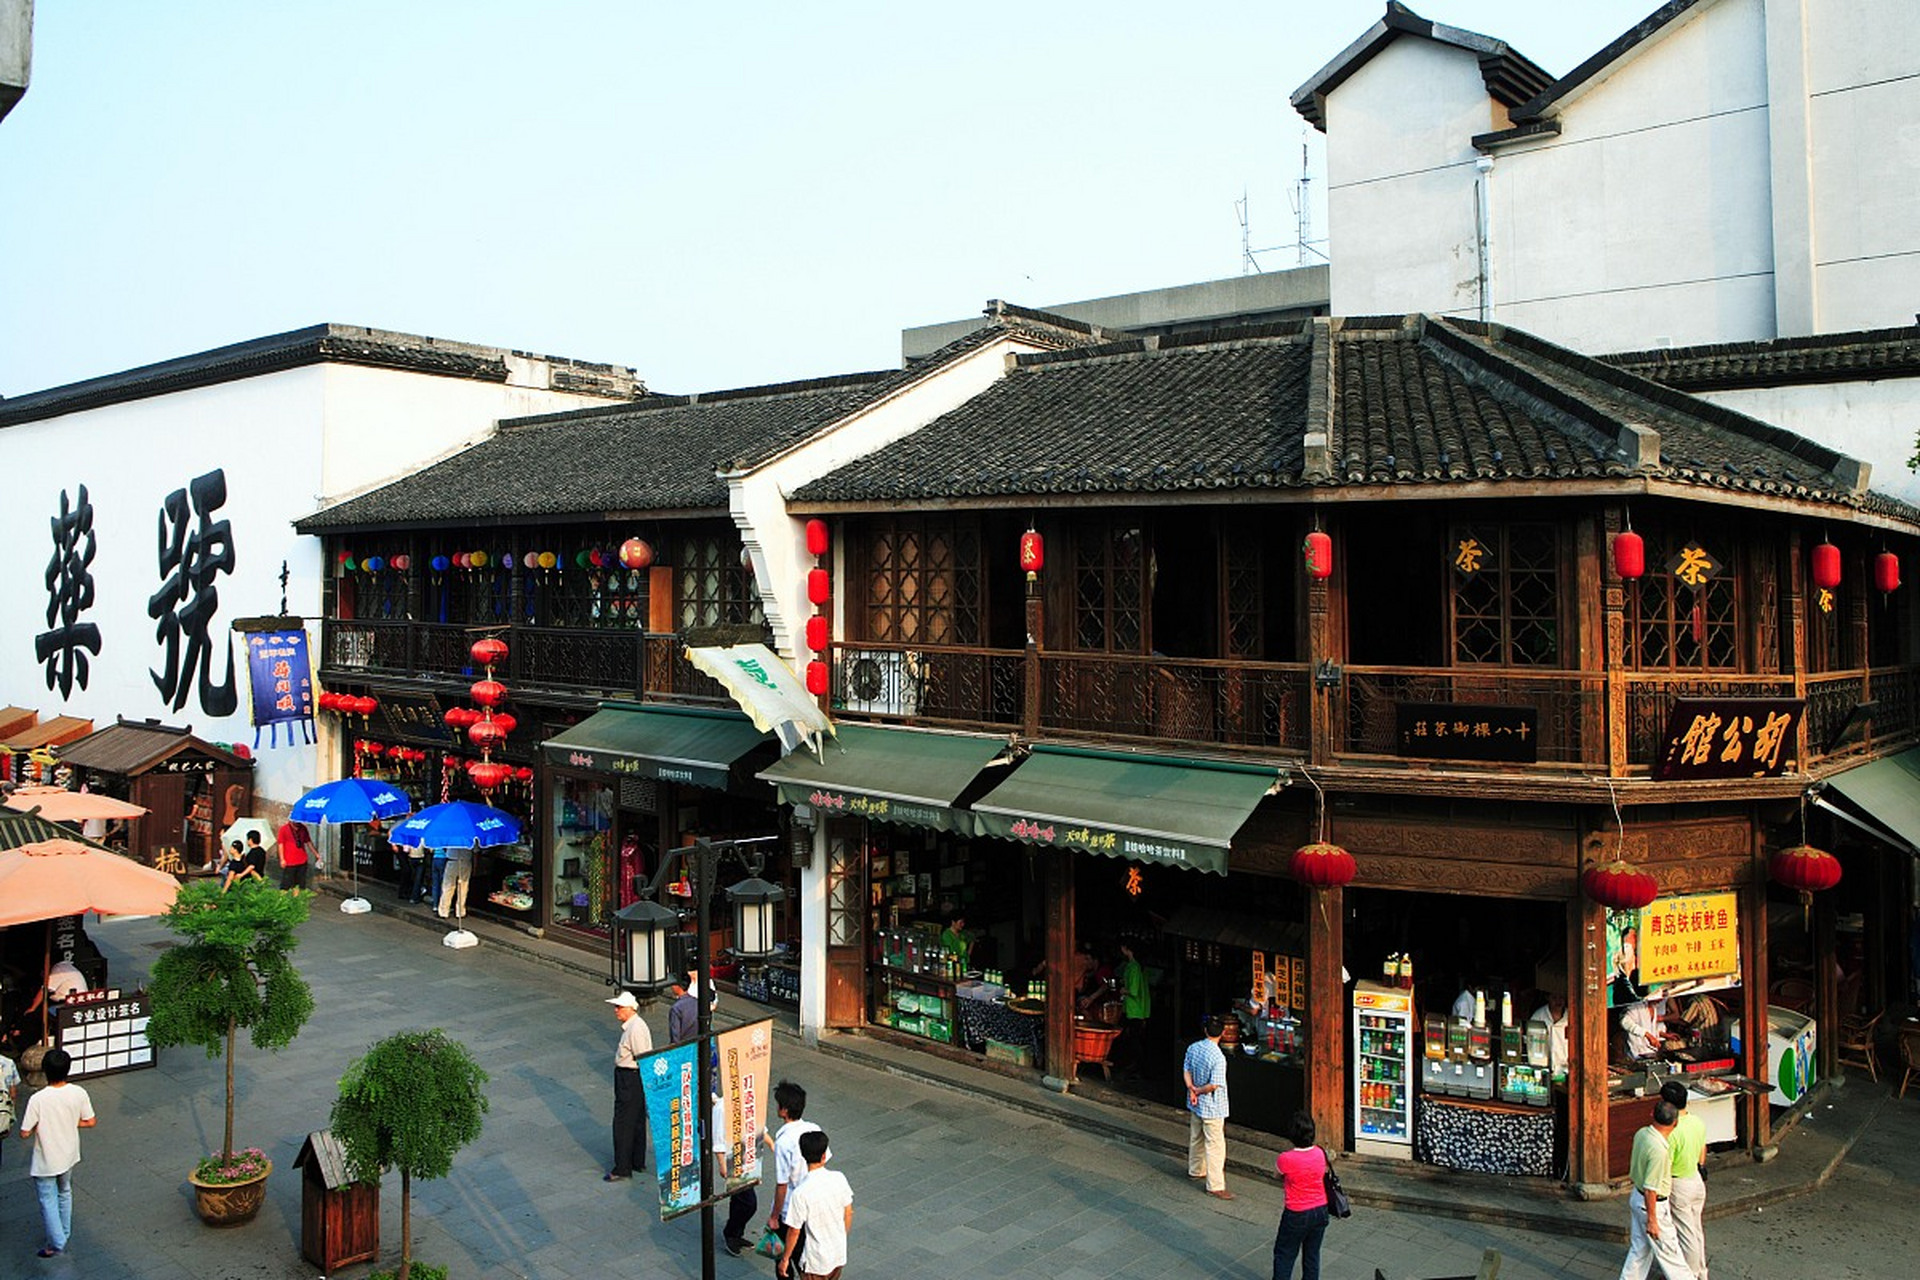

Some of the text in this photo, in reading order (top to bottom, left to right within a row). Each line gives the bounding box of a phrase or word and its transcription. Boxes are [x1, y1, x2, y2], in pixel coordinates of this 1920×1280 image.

[1455, 538, 1483, 573] 茶
[1675, 547, 1712, 586] 茶
[1818, 587, 1834, 614] 茶
[1010, 818, 1056, 842] 娃哈哈
[154, 846, 187, 874] 梳
[1125, 866, 1144, 896] 茶
[1650, 909, 1729, 937] 青岛铁板鱿鱼
[72, 1002, 141, 1024] 专业设计签名
